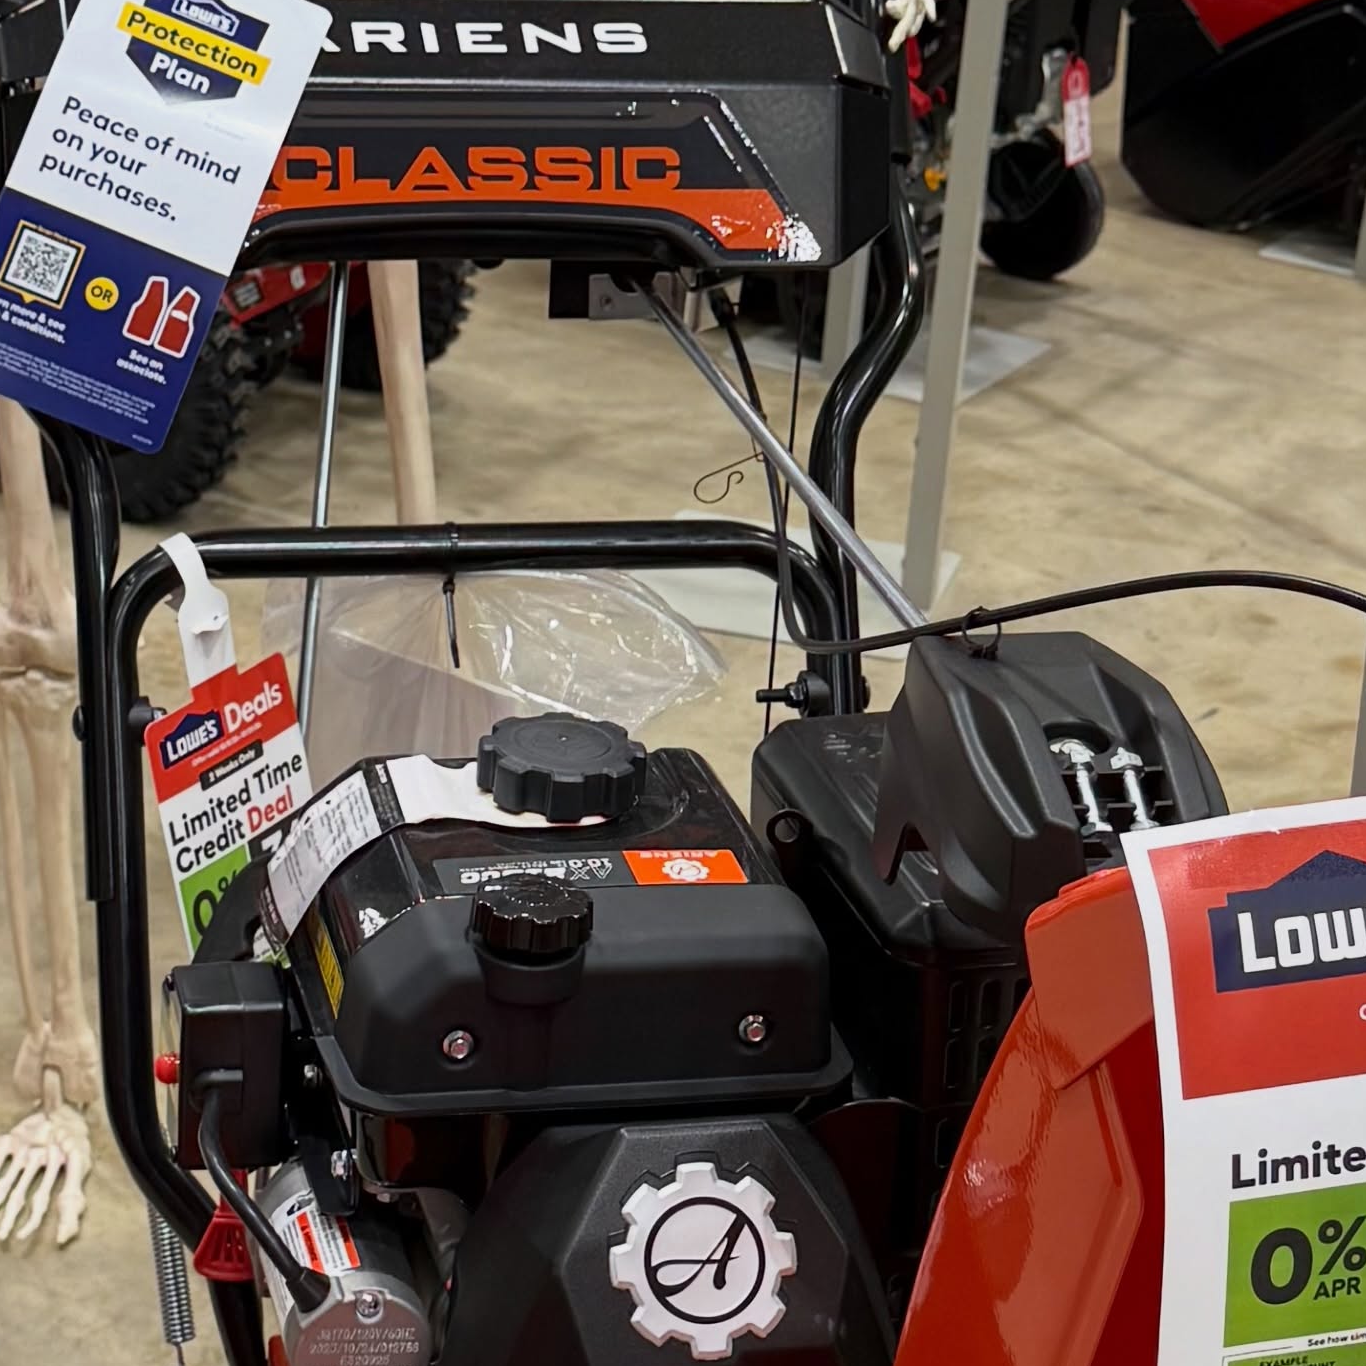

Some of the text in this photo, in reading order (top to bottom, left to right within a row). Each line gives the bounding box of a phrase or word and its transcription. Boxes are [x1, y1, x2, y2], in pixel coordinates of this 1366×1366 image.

[180, 0, 233, 34] LOWE'S
[127, 10, 257, 78] Protection
[150, 52, 211, 94] Plan
[52, 129, 147, 176] on your
[62, 96, 241, 185] Peace of mind
[39, 153, 177, 222] purchases.
[272, 146, 681, 192] CLASSIC
[91, 285, 112, 304] OR
[1, 310, 10, 322] &
[11, 314, 66, 344] conditions.
[11, 301, 37, 318] more
[38, 313, 47, 325] &
[48, 319, 66, 332] see
[116, 357, 167, 385] associate.
[129, 349, 164, 371] See an
[166, 719, 219, 762] LOWE'S
[223, 681, 283, 732] Deals
[169, 754, 302, 846] Limited Time
[176, 785, 294, 874] Credit Deal
[1313, 1279, 1362, 1301] APR
[1307, 1338, 1325, 1348] See
[1327, 1335, 1348, 1346] how
